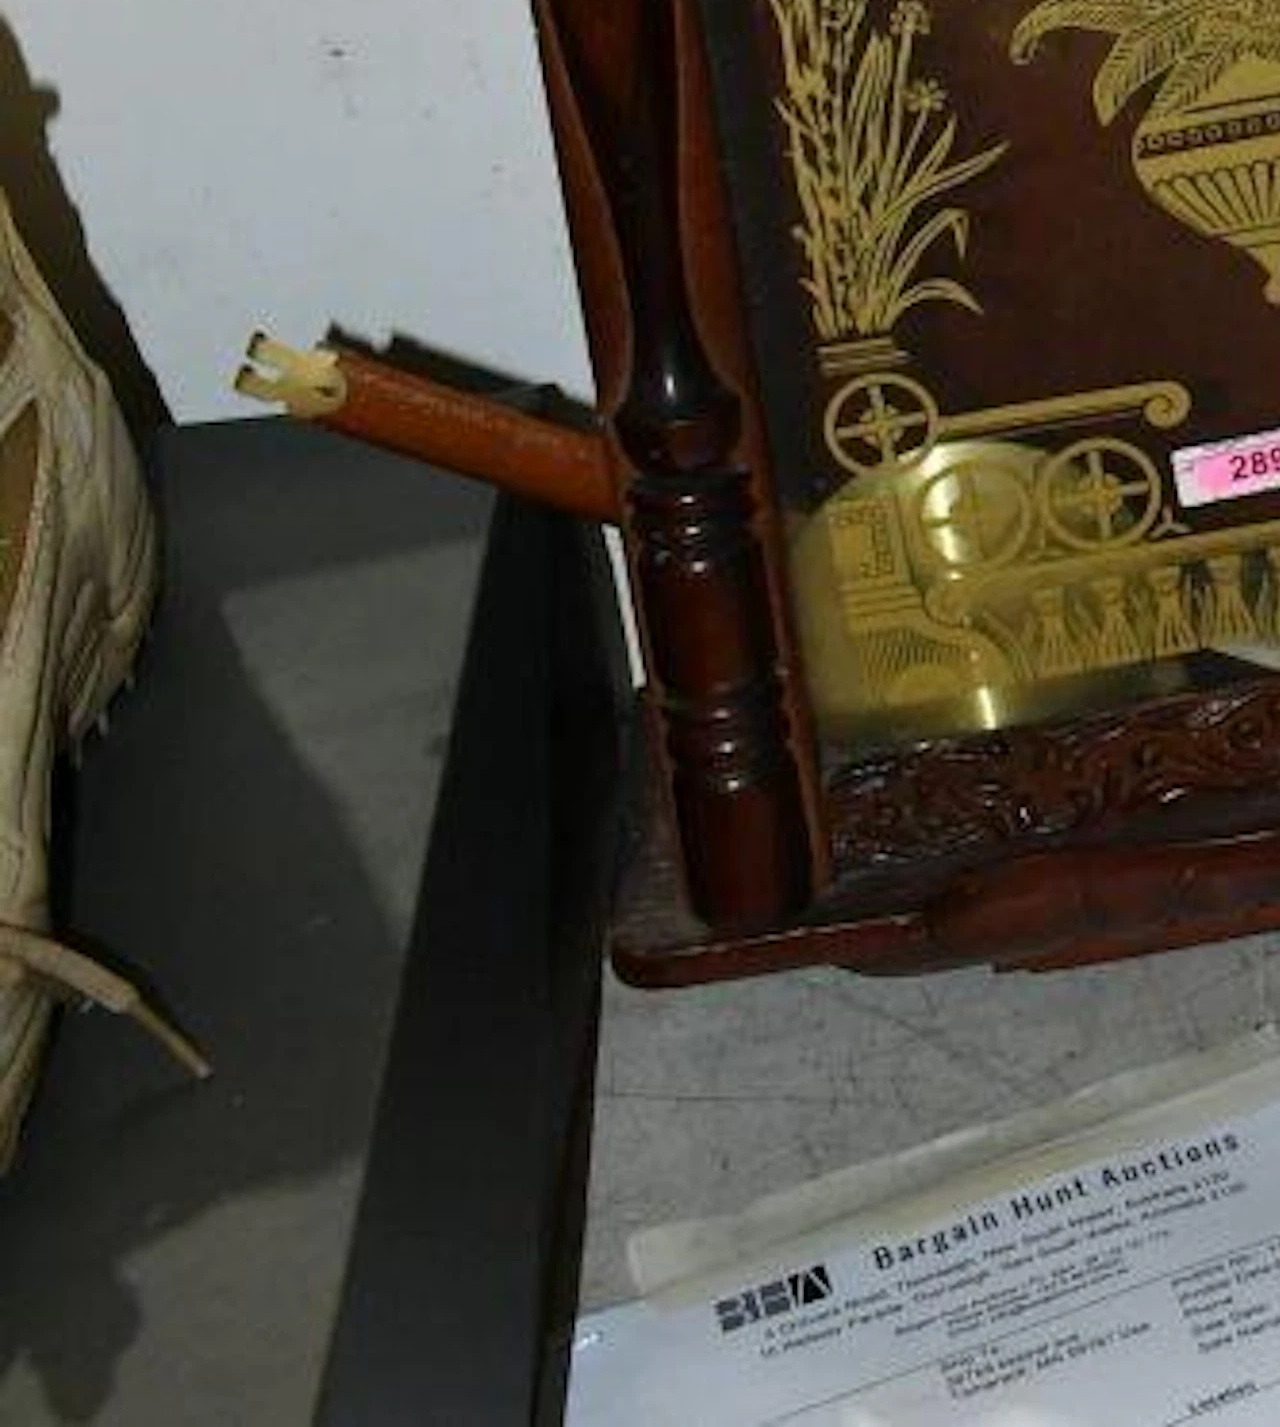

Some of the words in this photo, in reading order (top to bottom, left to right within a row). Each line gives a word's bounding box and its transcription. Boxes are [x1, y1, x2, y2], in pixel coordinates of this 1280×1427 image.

[871, 1214, 999, 1271] Bargain
[1009, 1177, 1091, 1221] Hunt
[1101, 1133, 1241, 1187] Auctions
